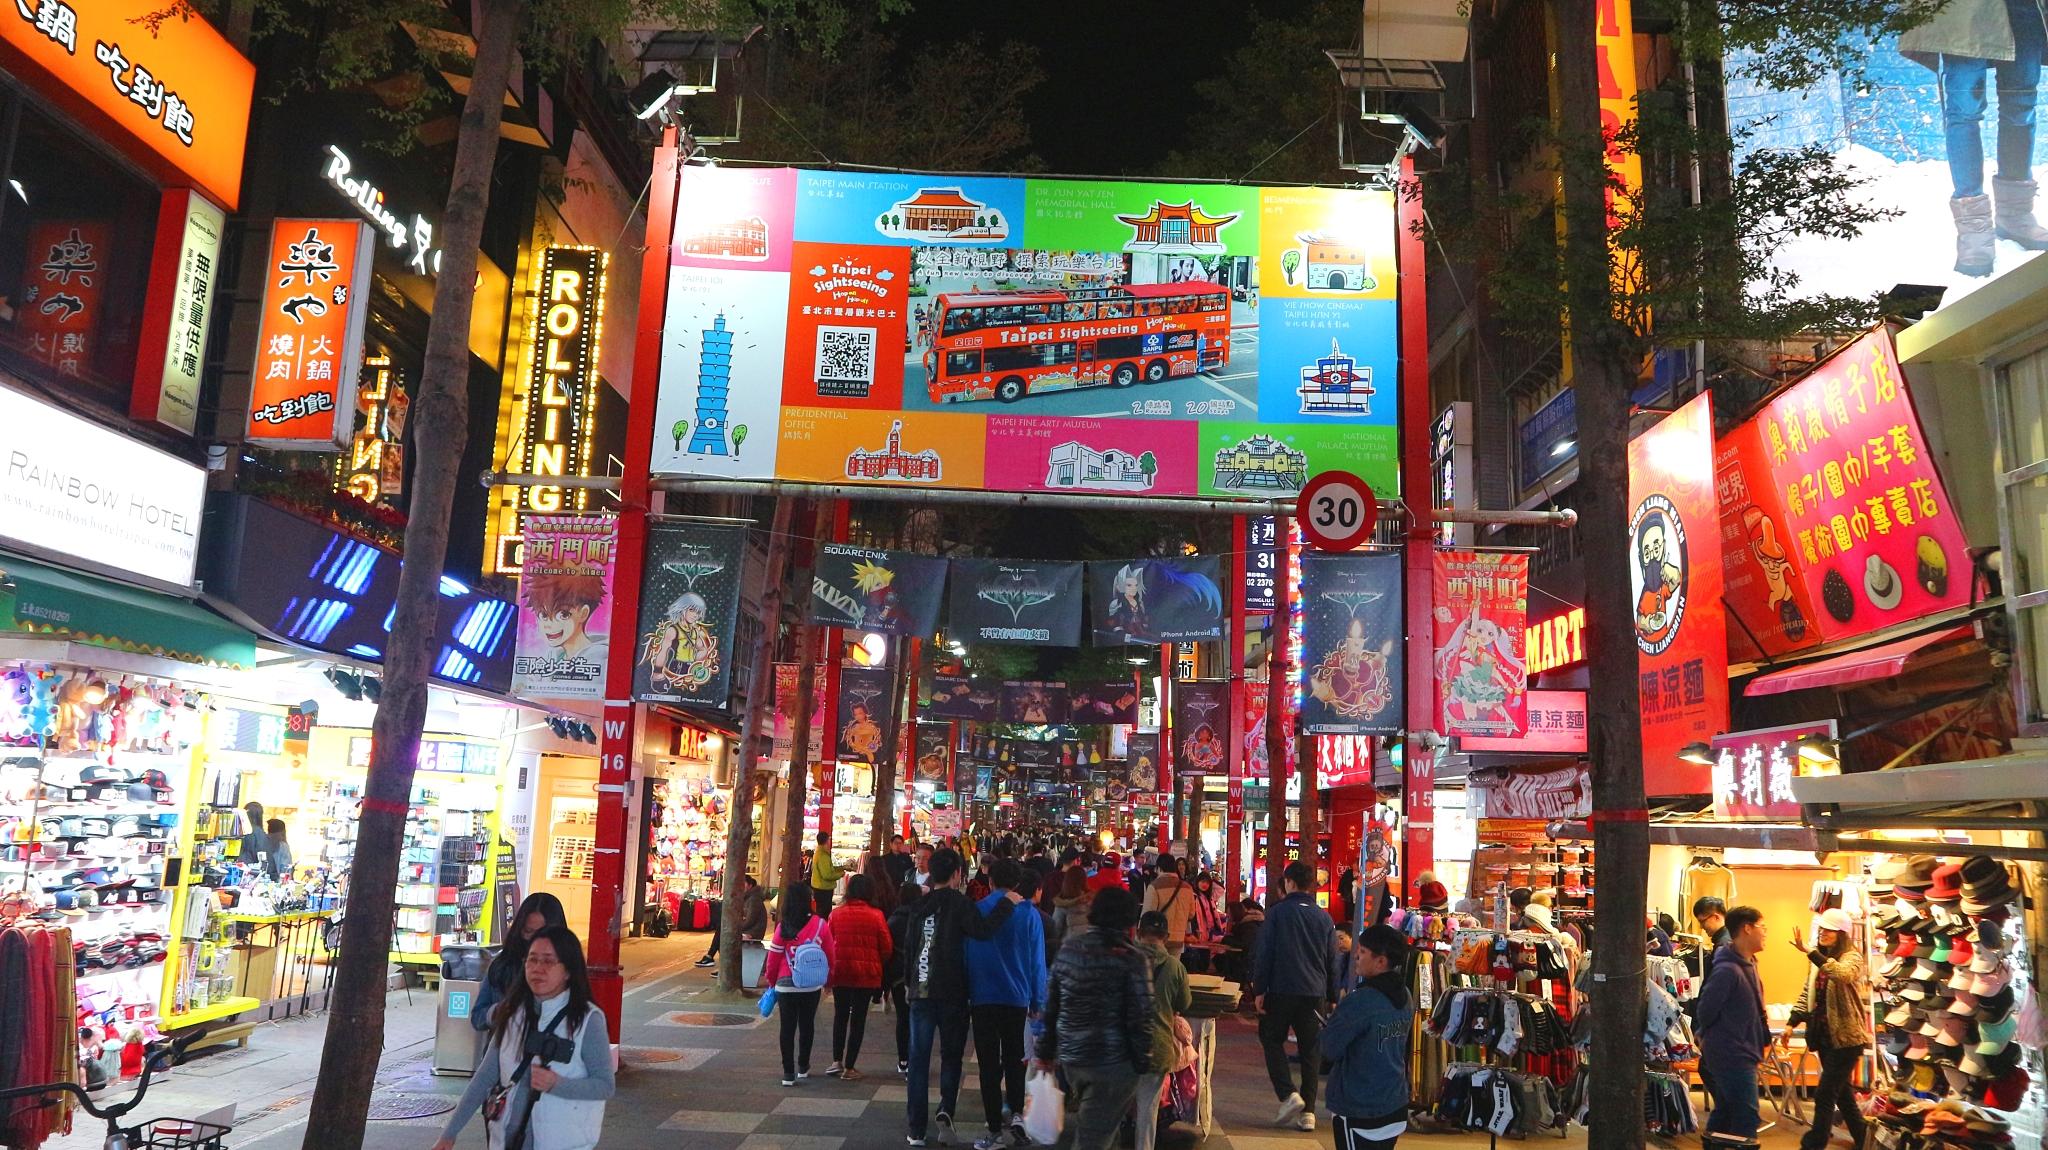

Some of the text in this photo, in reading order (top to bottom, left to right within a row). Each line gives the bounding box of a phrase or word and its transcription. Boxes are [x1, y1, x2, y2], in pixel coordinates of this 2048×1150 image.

[97, 41, 193, 146] 吃到飽
[808, 179, 909, 191] TAIPEI MAIN STATION
[328, 144, 408, 249] Rolling
[1035, 199, 1088, 208] MEMORIAL
[917, 252, 1124, 269] 以全新視野 探索玩樂台北
[832, 264, 871, 276] Taipei
[813, 277, 888, 297] Sightseeing
[802, 305, 897, 318] 臺北市雙層觀光巴士
[1001, 325, 1138, 344] Taipei Sightseeing
[265, 334, 295, 381] 燒肉
[306, 335, 335, 381] 火鍋
[528, 269, 581, 512] ROLLING
[254, 392, 333, 424] 吃到飽
[785, 408, 848, 420] PRESIDENTIAL
[1134, 401, 1144, 414] 2
[1187, 402, 1209, 414] 20
[785, 420, 816, 430] OFFICE
[1063, 421, 1102, 429] MUSEUM
[1316, 442, 1350, 450] PALACE
[9, 450, 194, 537] RAINBOW HOTEL
[1315, 497, 1358, 528] 30
[1628, 496, 1685, 545] CHEN LIANG MIAN
[530, 538, 613, 565] 西門町
[824, 547, 888, 560] SQUARE ENIX
[529, 567, 606, 577] Welcome to Ximen
[1246, 578, 1255, 587] 02
[1447, 577, 1520, 601] 西門町
[1160, 629, 1211, 638] iPhone Android
[1637, 597, 1687, 654] CHEN LIANGMIAN
[515, 656, 601, 680] 冒險少年浩平
[1640, 659, 1705, 714] 陳涼麵
[1528, 709, 1585, 729] 陳涼麵
[605, 720, 625, 740] W
[602, 754, 625, 770] 16
[1410, 758, 1431, 778] W
[823, 771, 834, 781] W
[821, 788, 833, 797] 18
[1230, 787, 1241, 798] W
[1410, 791, 1433, 807] 15
[1229, 804, 1242, 814] 17
